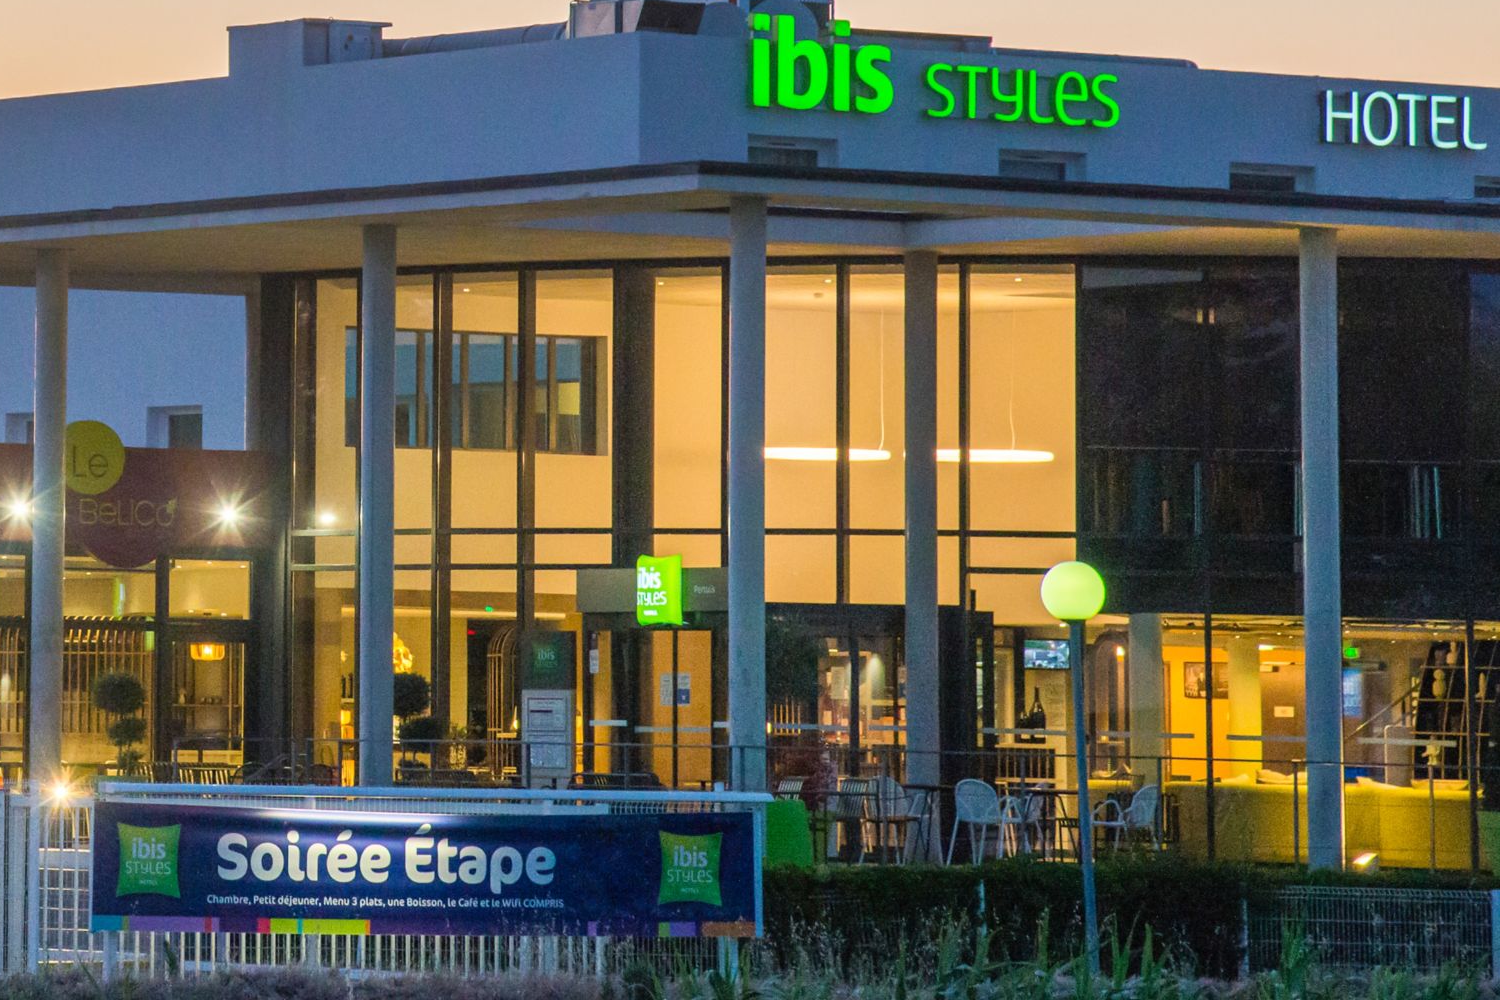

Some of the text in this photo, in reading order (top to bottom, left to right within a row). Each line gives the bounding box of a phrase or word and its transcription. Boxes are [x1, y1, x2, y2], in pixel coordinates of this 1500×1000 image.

[750, 12, 894, 114] ibis
[1325, 89, 1488, 150] HOTEL
[71, 445, 109, 478] Le
[637, 566, 662, 589] ibis
[132, 836, 166, 859] ibis
[217, 823, 557, 895] Soirée Étape
[673, 845, 708, 868] ibis
[206, 894, 251, 906] Chambre,
[253, 895, 276, 905] Petit
[277, 895, 322, 907] déjeuner,
[323, 896, 350, 906] Menu
[351, 896, 358, 906] 3
[359, 896, 386, 908] plats,
[387, 899, 405, 907] une
[406, 897, 446, 909] Boisson,
[447, 897, 457, 908] le
[458, 897, 479, 908] Café
[480, 899, 490, 908] et
[491, 898, 500, 908] le
[523, 898, 565, 909] COMPRIS
